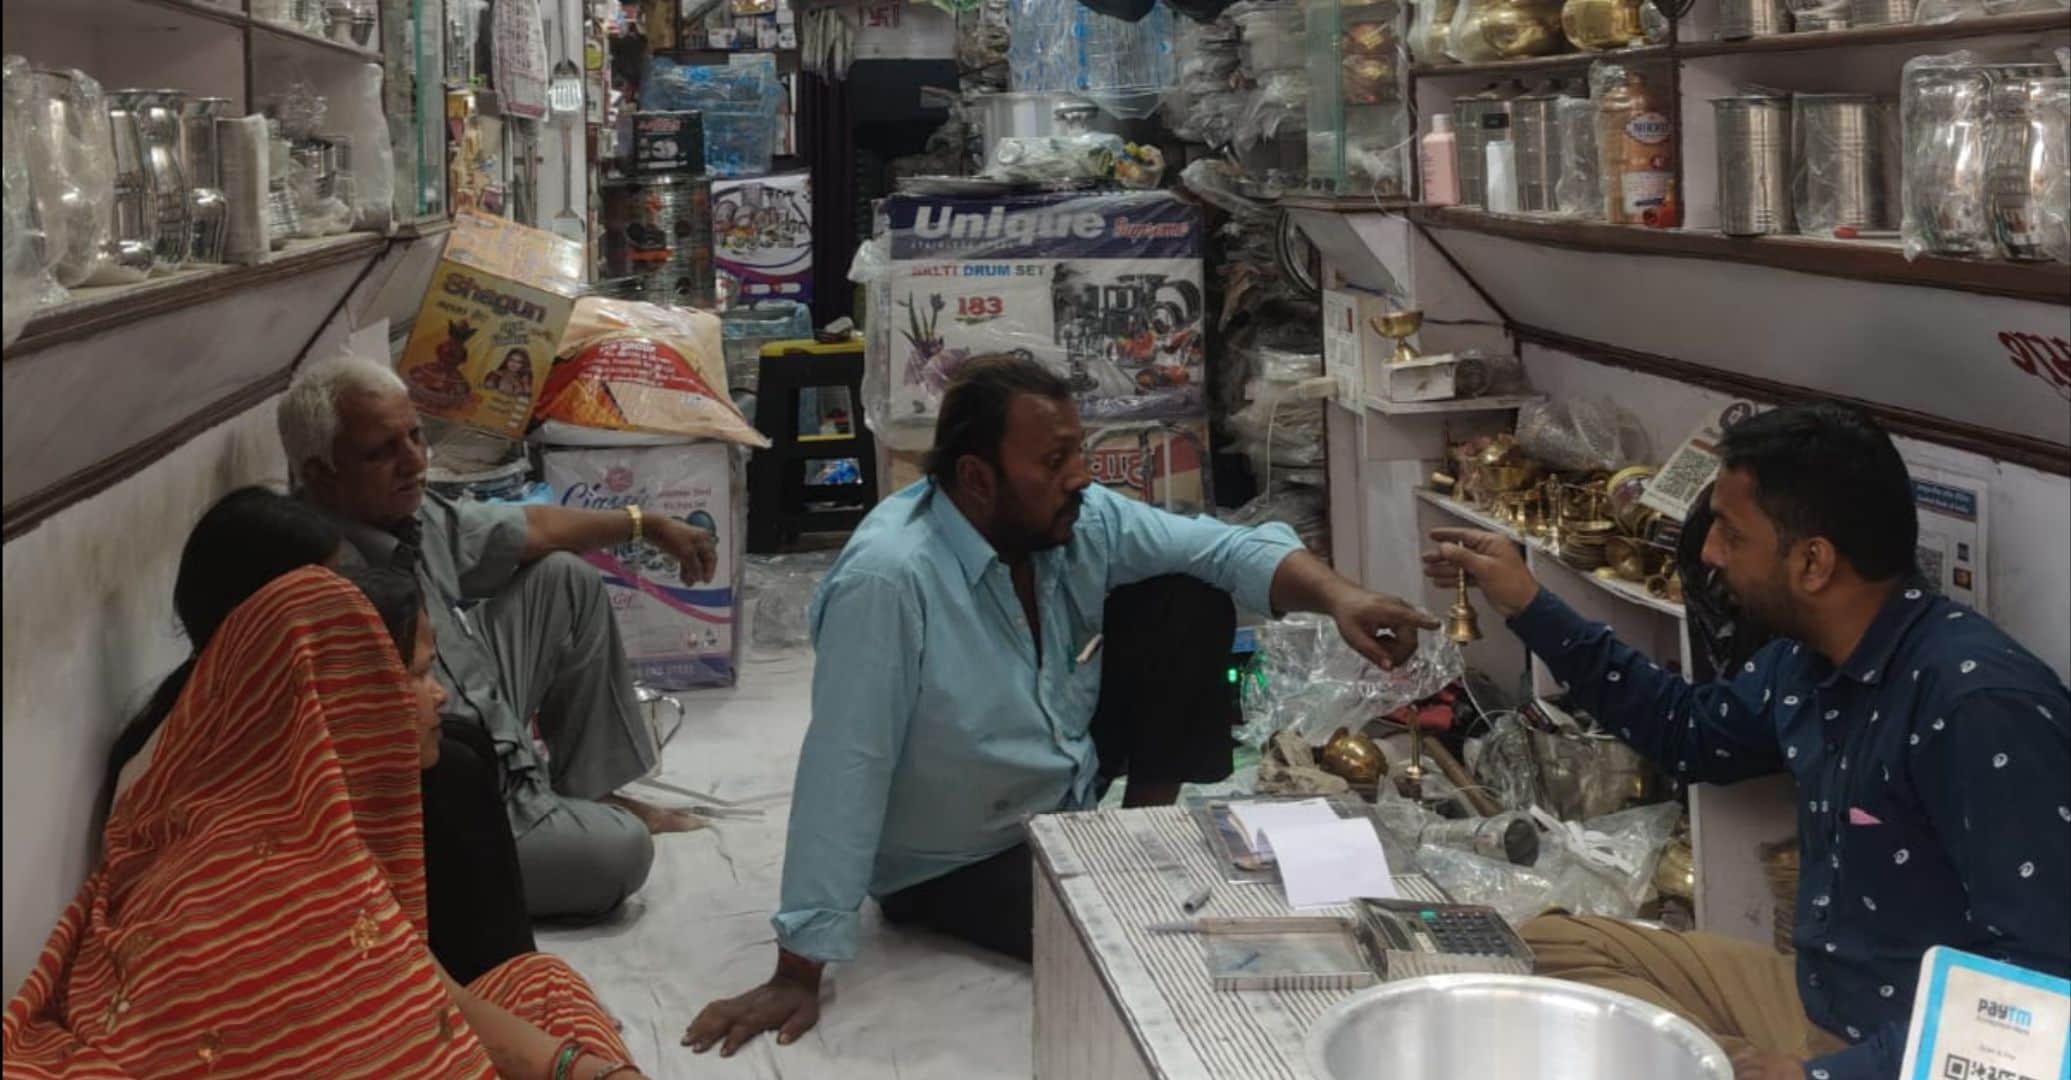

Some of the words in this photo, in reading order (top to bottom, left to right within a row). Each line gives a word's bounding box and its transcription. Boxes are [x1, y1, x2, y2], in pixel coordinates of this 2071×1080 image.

[913, 206, 1106, 245] Unique
[963, 264, 1011, 277] DRUM
[1015, 265, 1044, 277] SET
[443, 272, 546, 324] Shagun
[957, 297, 1004, 315] 183
